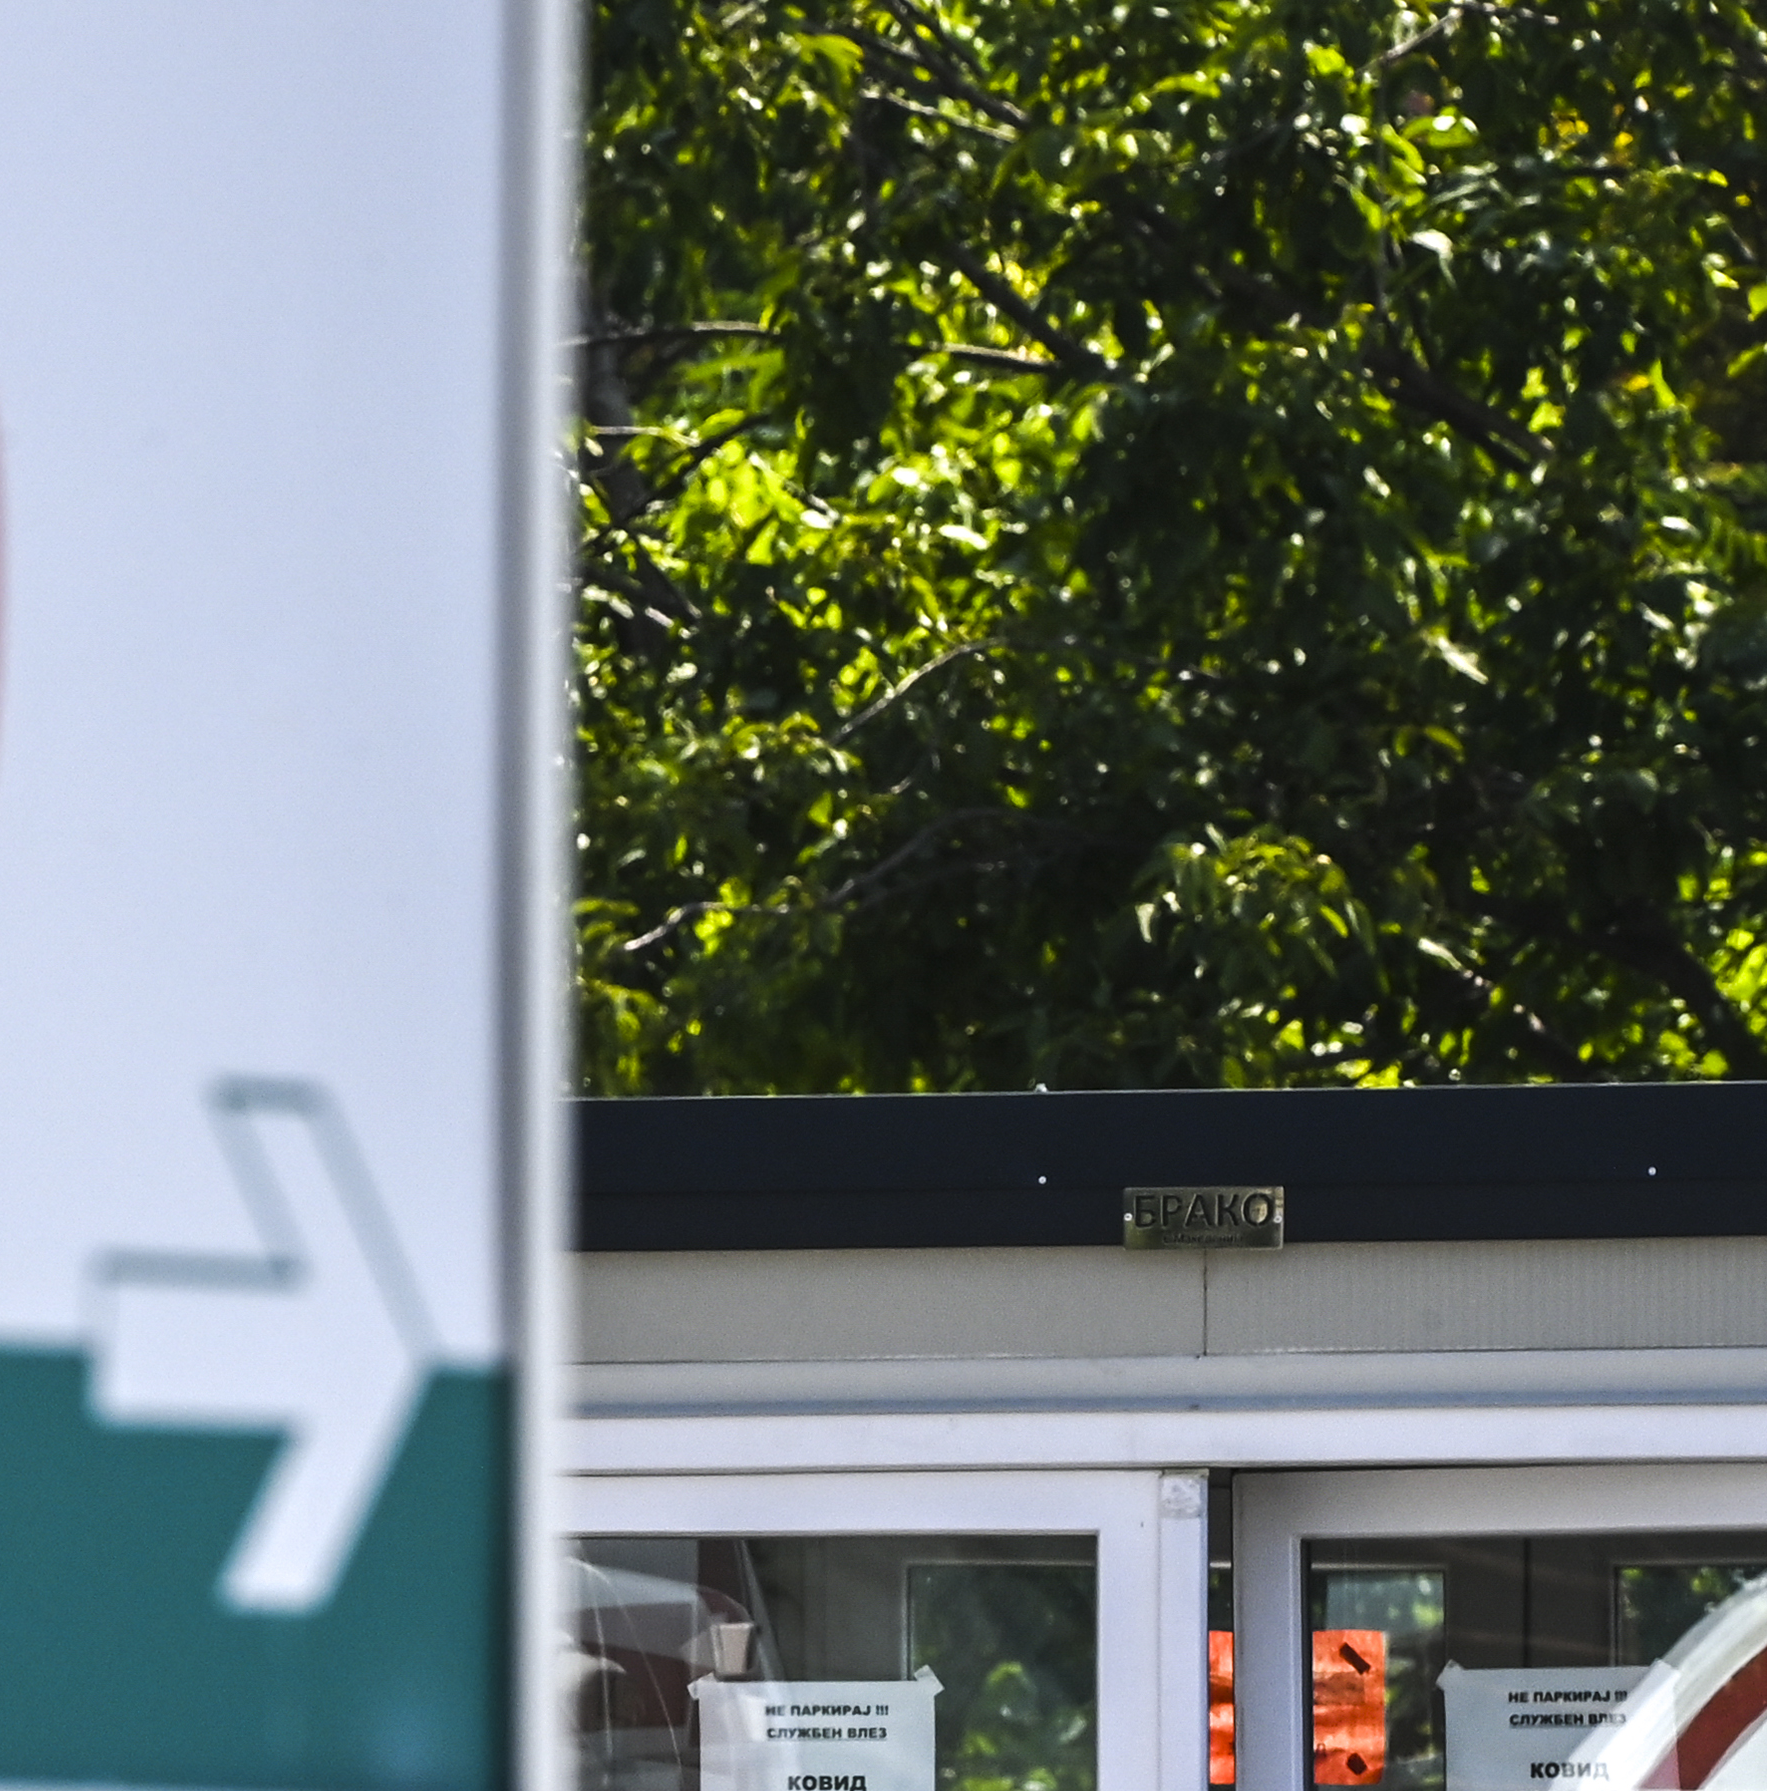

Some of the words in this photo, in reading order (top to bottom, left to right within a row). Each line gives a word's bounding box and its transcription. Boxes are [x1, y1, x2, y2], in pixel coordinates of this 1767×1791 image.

[1133, 1193, 1274, 1229] БРАКО
[1508, 1690, 1529, 1703] НЕ
[1533, 1690, 1610, 1703] ПАРКИРАЈ
[765, 1704, 785, 1716] НЕ
[790, 1704, 871, 1717] ПАРКИРАЈ
[875, 1704, 889, 1716] !!!
[1509, 1714, 1584, 1726] СЛУЖБЕН
[767, 1727, 843, 1739] СЛУЖБЕН
[847, 1727, 888, 1739] ВЛЕЗ
[1530, 1762, 1609, 1780] КОВИД
